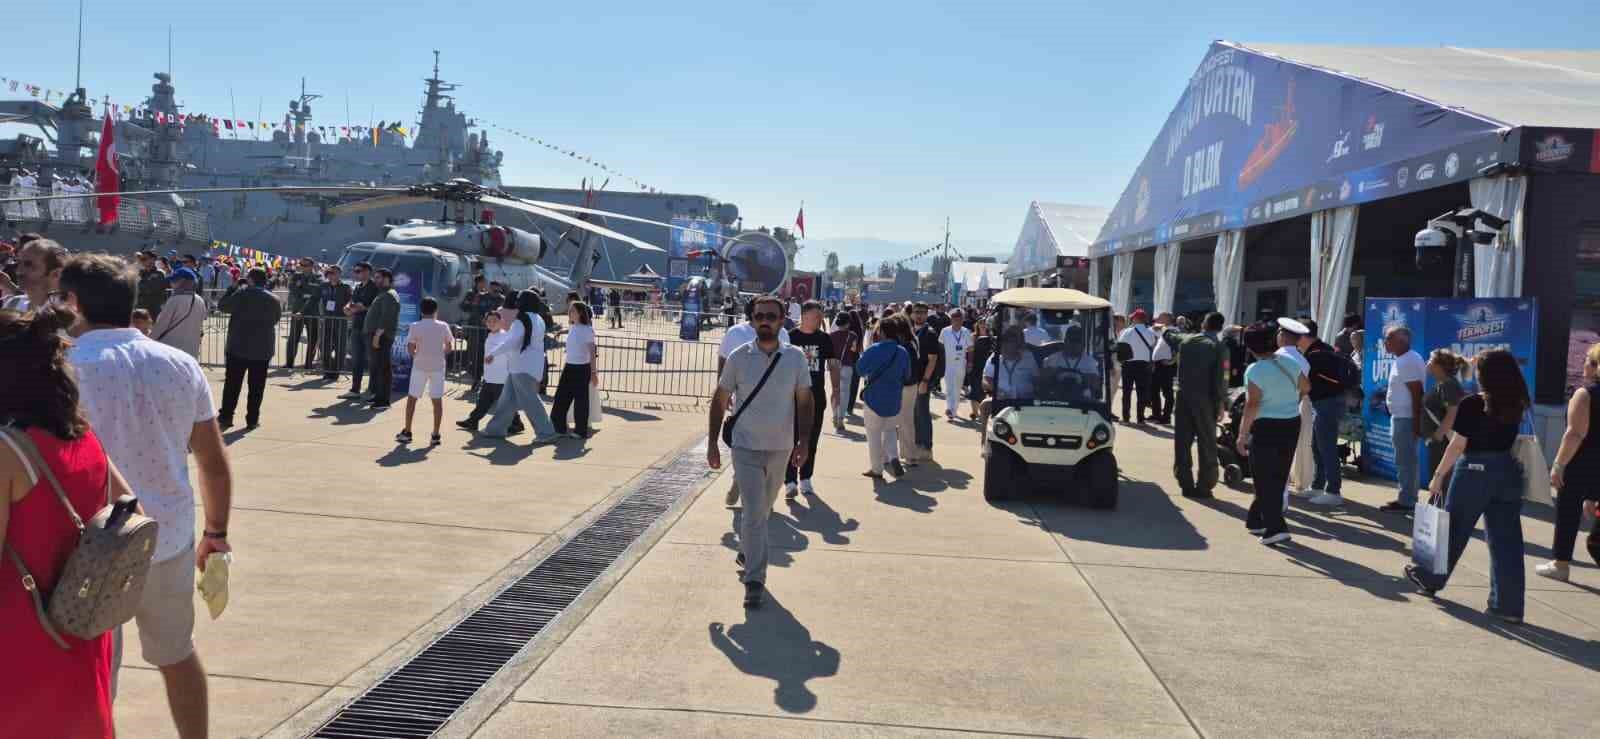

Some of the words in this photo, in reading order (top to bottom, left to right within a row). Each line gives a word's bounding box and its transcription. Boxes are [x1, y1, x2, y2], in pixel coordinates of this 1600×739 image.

[1202, 65, 1255, 127] VATAN
[1183, 155, 1192, 198] D
[1191, 140, 1224, 193] BLOK
